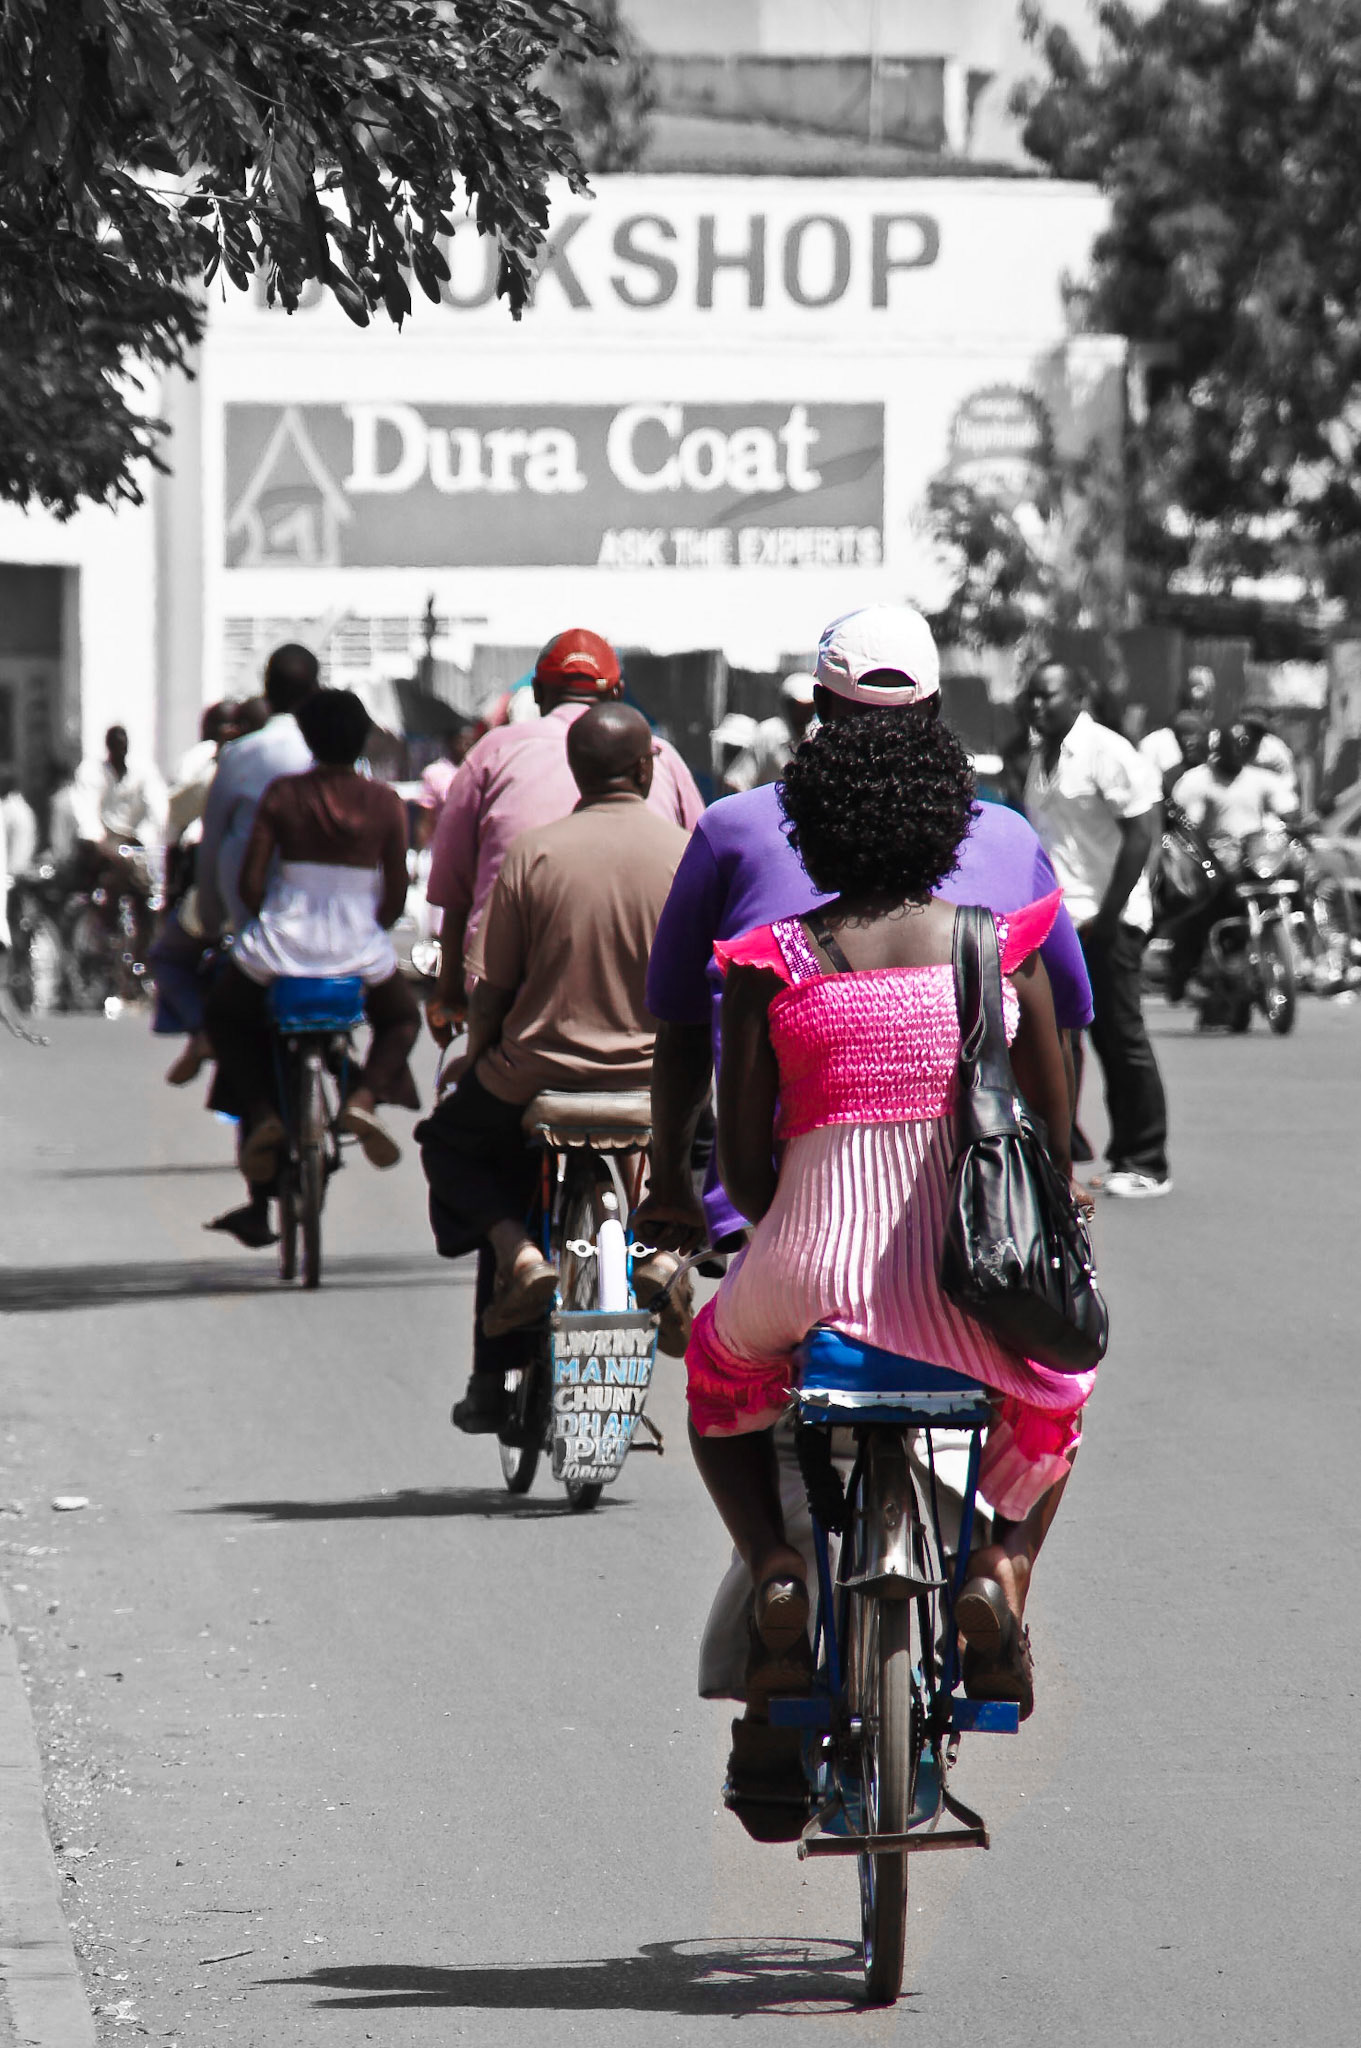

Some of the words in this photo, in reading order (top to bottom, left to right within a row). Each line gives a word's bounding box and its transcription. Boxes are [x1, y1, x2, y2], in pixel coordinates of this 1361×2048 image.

[253, 212, 940, 309] OKSHOP
[342, 402, 588, 493] Dura
[606, 402, 822, 493] Coat
[598, 527, 668, 567] ASK
[670, 526, 733, 567] THE
[738, 525, 882, 567] EXPERTS
[554, 1386, 649, 1413] CHUNY
